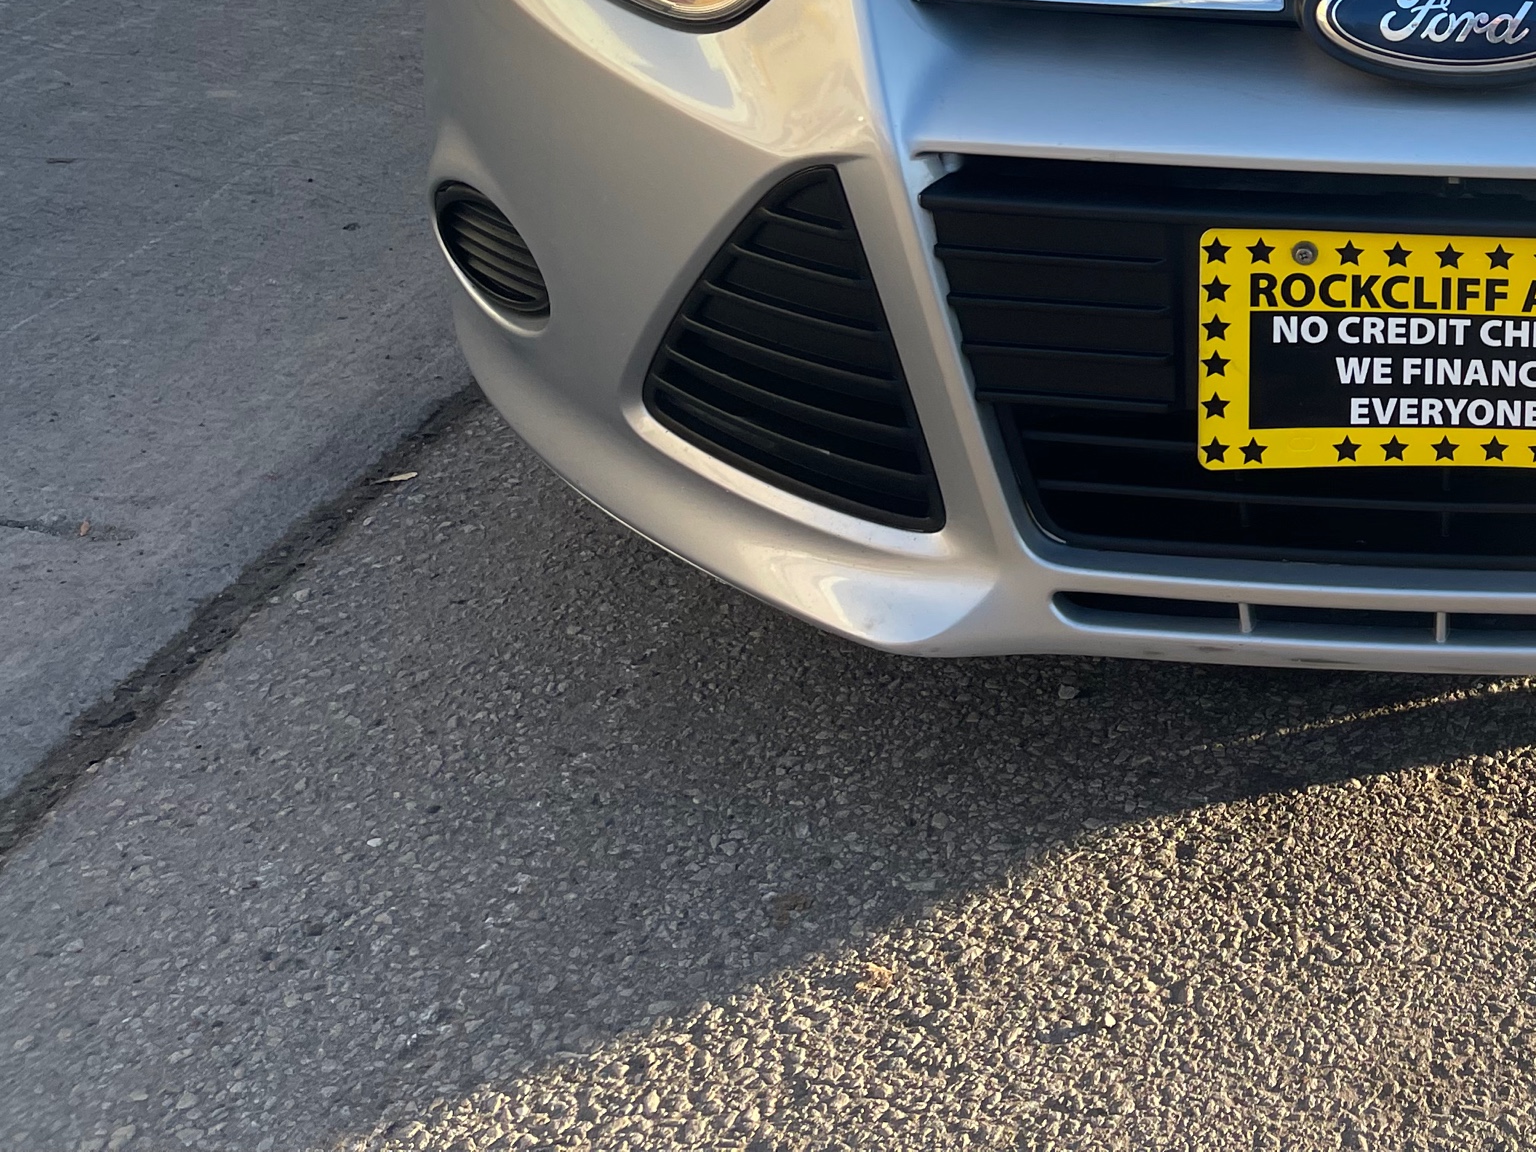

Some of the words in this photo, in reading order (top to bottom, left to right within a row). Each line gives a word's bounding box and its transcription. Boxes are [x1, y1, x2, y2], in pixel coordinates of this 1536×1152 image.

[1249, 272, 1509, 312] ROCKCLIFF
[1272, 315, 1328, 344] NO
[1337, 315, 1472, 347] CREDIT
[1335, 356, 1393, 385] WE
